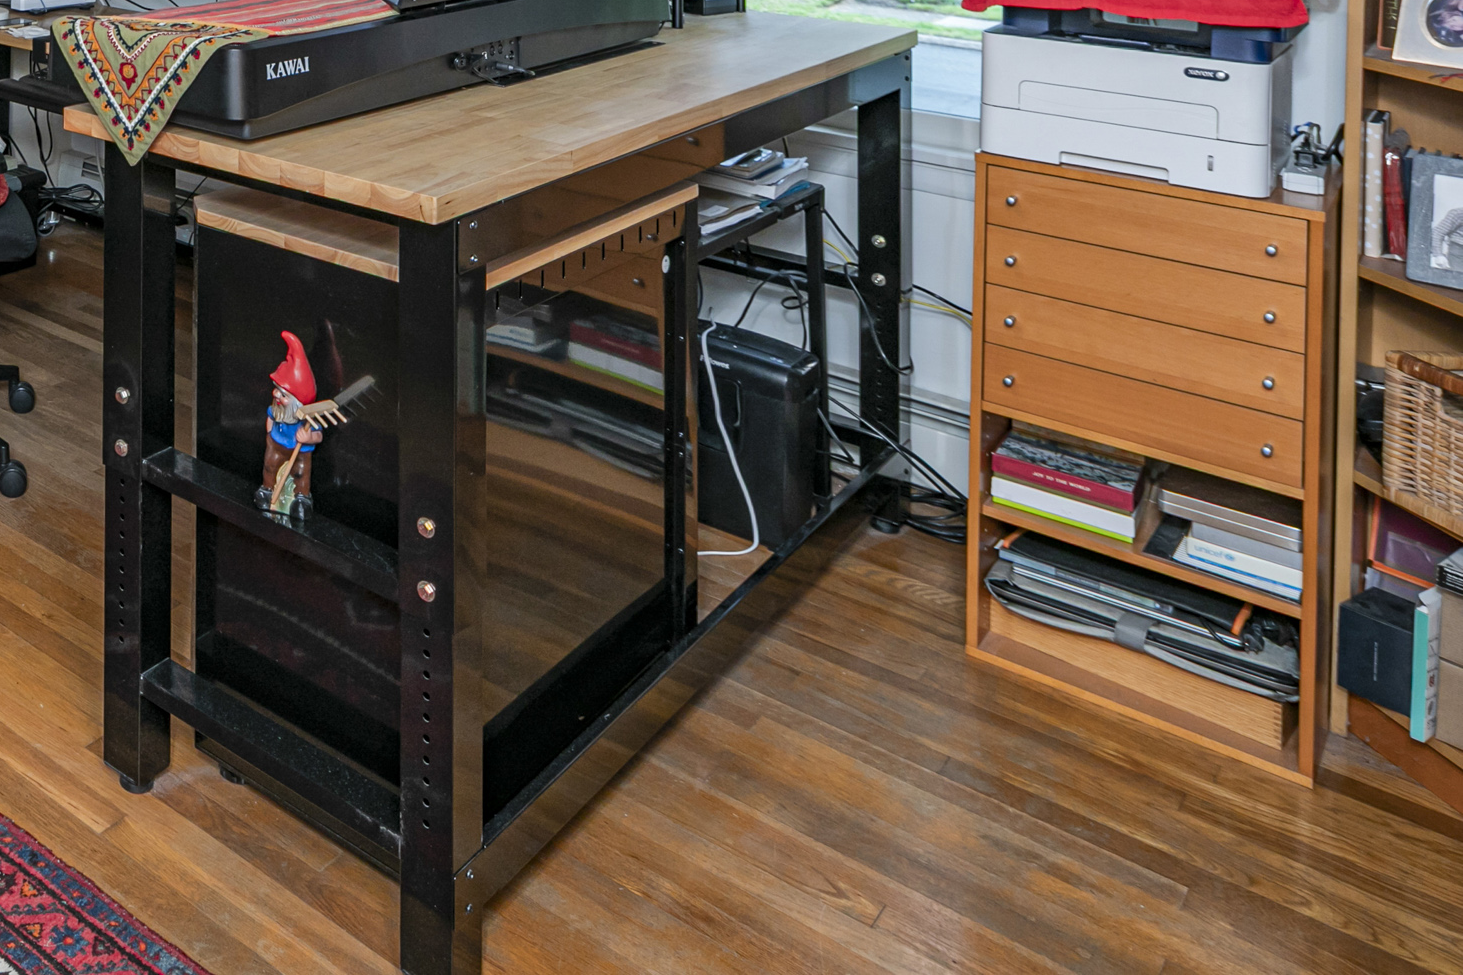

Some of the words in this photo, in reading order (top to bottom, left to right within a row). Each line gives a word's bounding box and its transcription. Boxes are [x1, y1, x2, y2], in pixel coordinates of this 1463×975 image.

[266, 56, 310, 81] KAWAI
[1188, 68, 1215, 78] xerox
[1055, 477, 1068, 485] THE
[1068, 481, 1091, 492] WORLD
[1194, 545, 1223, 557] unicef
